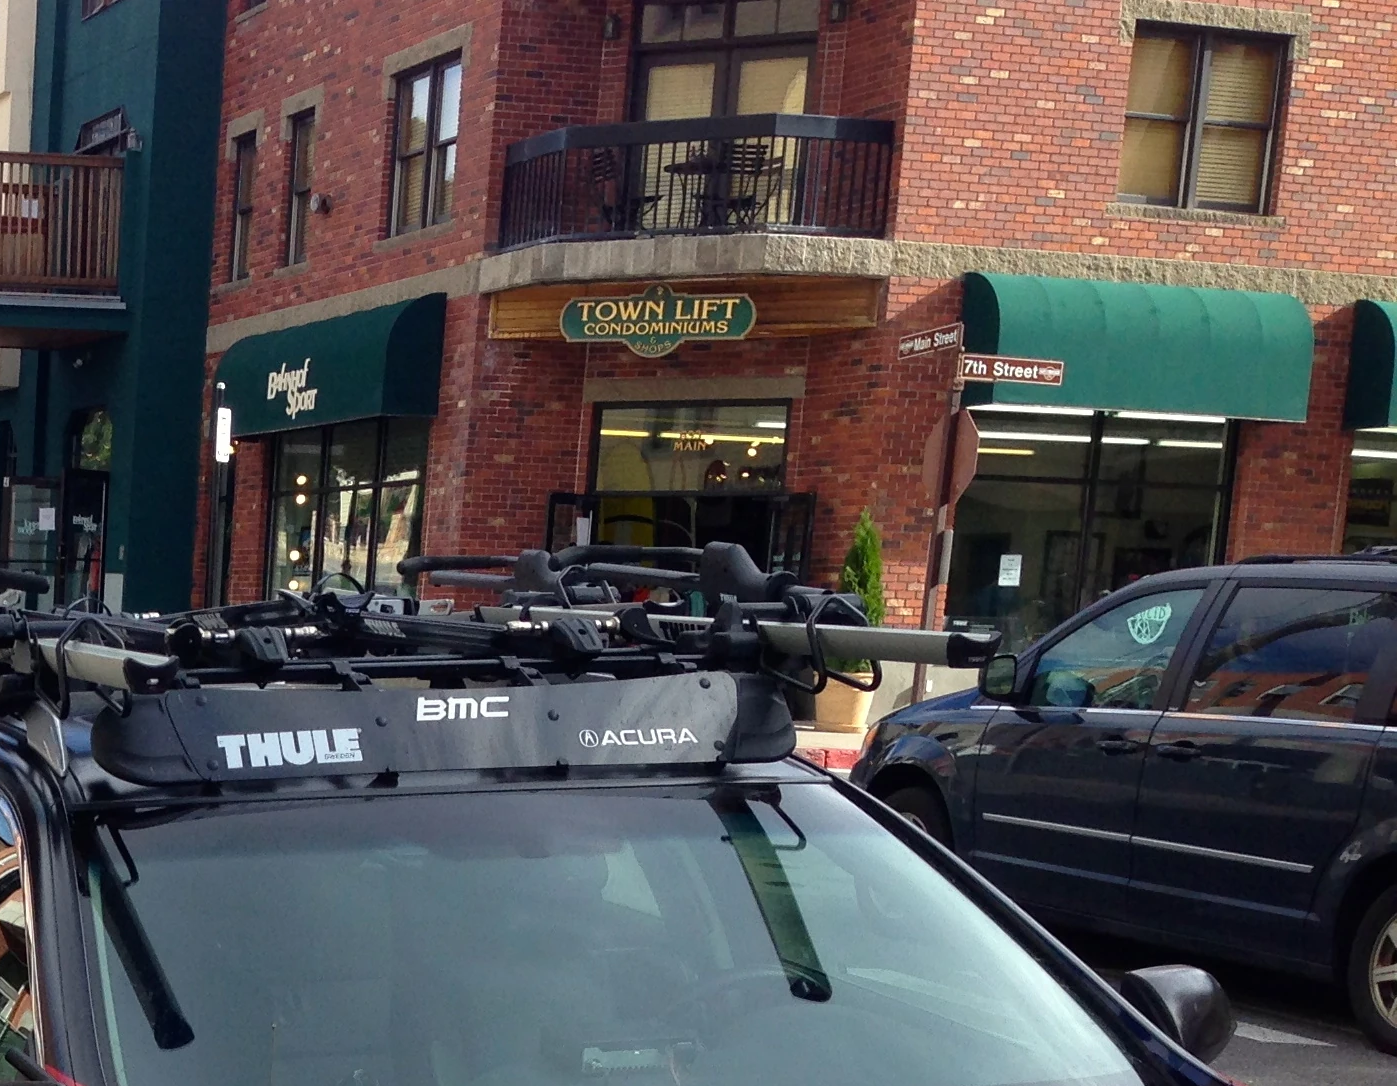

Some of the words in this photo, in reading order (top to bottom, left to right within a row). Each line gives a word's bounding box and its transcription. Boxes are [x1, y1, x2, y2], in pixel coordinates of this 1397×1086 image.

[577, 301, 665, 322] TOWN
[675, 299, 740, 320] LIFT
[584, 321, 729, 336] CONDOMINIUMS
[634, 340, 673, 354] SHOPS
[913, 337, 931, 351] Main
[933, 329, 958, 347] Street
[964, 359, 987, 375] 7th
[993, 360, 1039, 379] Street
[673, 440, 707, 452] MAIN
[416, 696, 511, 722] BMC
[601, 727, 699, 746] ACURA
[216, 728, 363, 769] THULE
